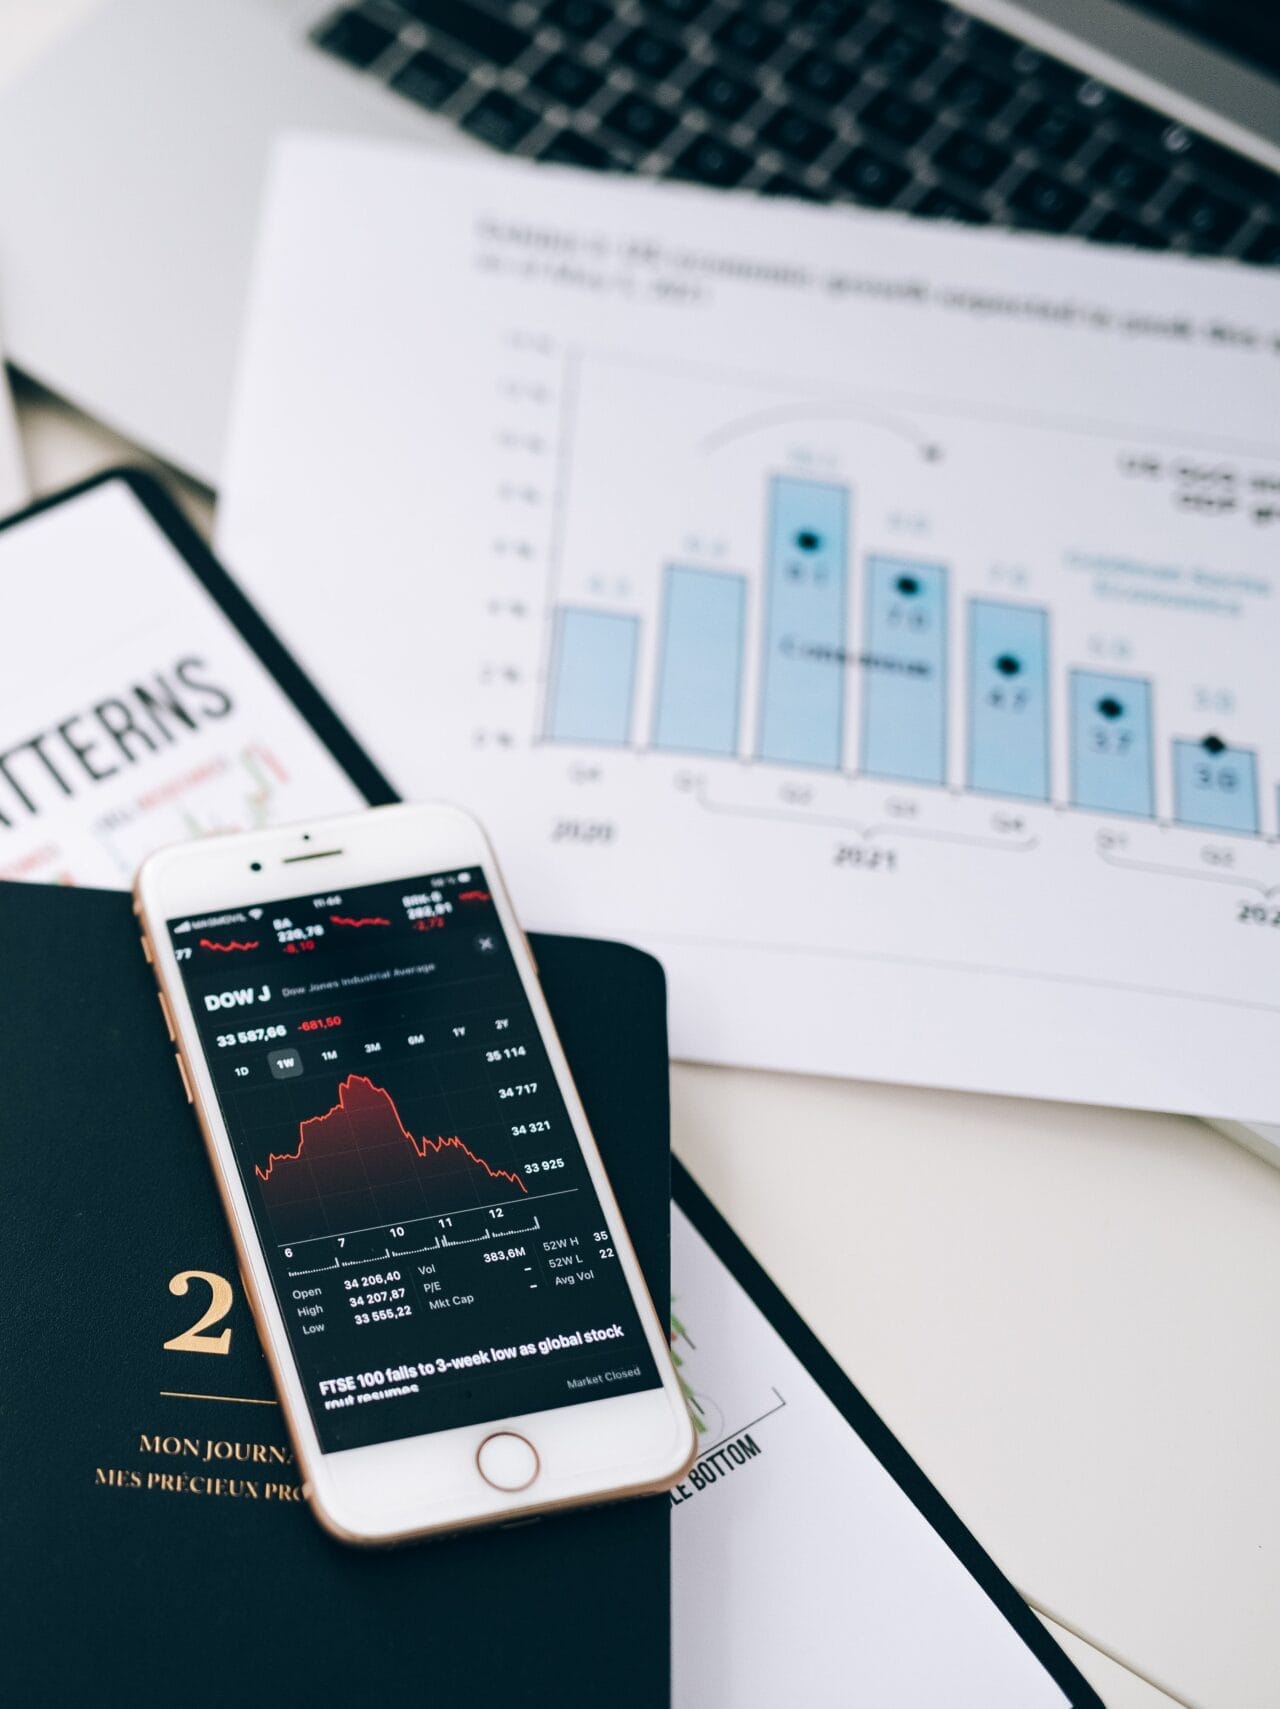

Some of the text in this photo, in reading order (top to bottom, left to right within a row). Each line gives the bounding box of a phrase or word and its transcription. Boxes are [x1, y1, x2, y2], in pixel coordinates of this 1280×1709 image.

[204, 963, 436, 1011] DOW J Dow Jones Industrial Average
[216, 1015, 343, 1048] 33 587,66 -681,50
[234, 1018, 509, 1077] 1D 1W 1M 3M 6M 1Y 2Y
[284, 1207, 504, 1258] 6 7 10 11 12
[292, 1230, 609, 1301] Open 34 206,40 Vol 383,6M 52W H 35
[297, 1248, 615, 1318] High 34 207,87 P/E 52W L 22
[163, 1269, 234, 1355] 2
[302, 1270, 595, 1336] Low 33 555,22 Mkt Cap Avg Vol
[319, 1324, 625, 1396] FTSE 100 falls to 3-week low as global stock
[567, 1366, 642, 1389] Market Closed
[139, 1434, 200, 1457] MON
[688, 1434, 762, 1491] BOTTOM
[95, 1467, 142, 1488] MES
[147, 1472, 259, 1499] PRÉCIEUX
